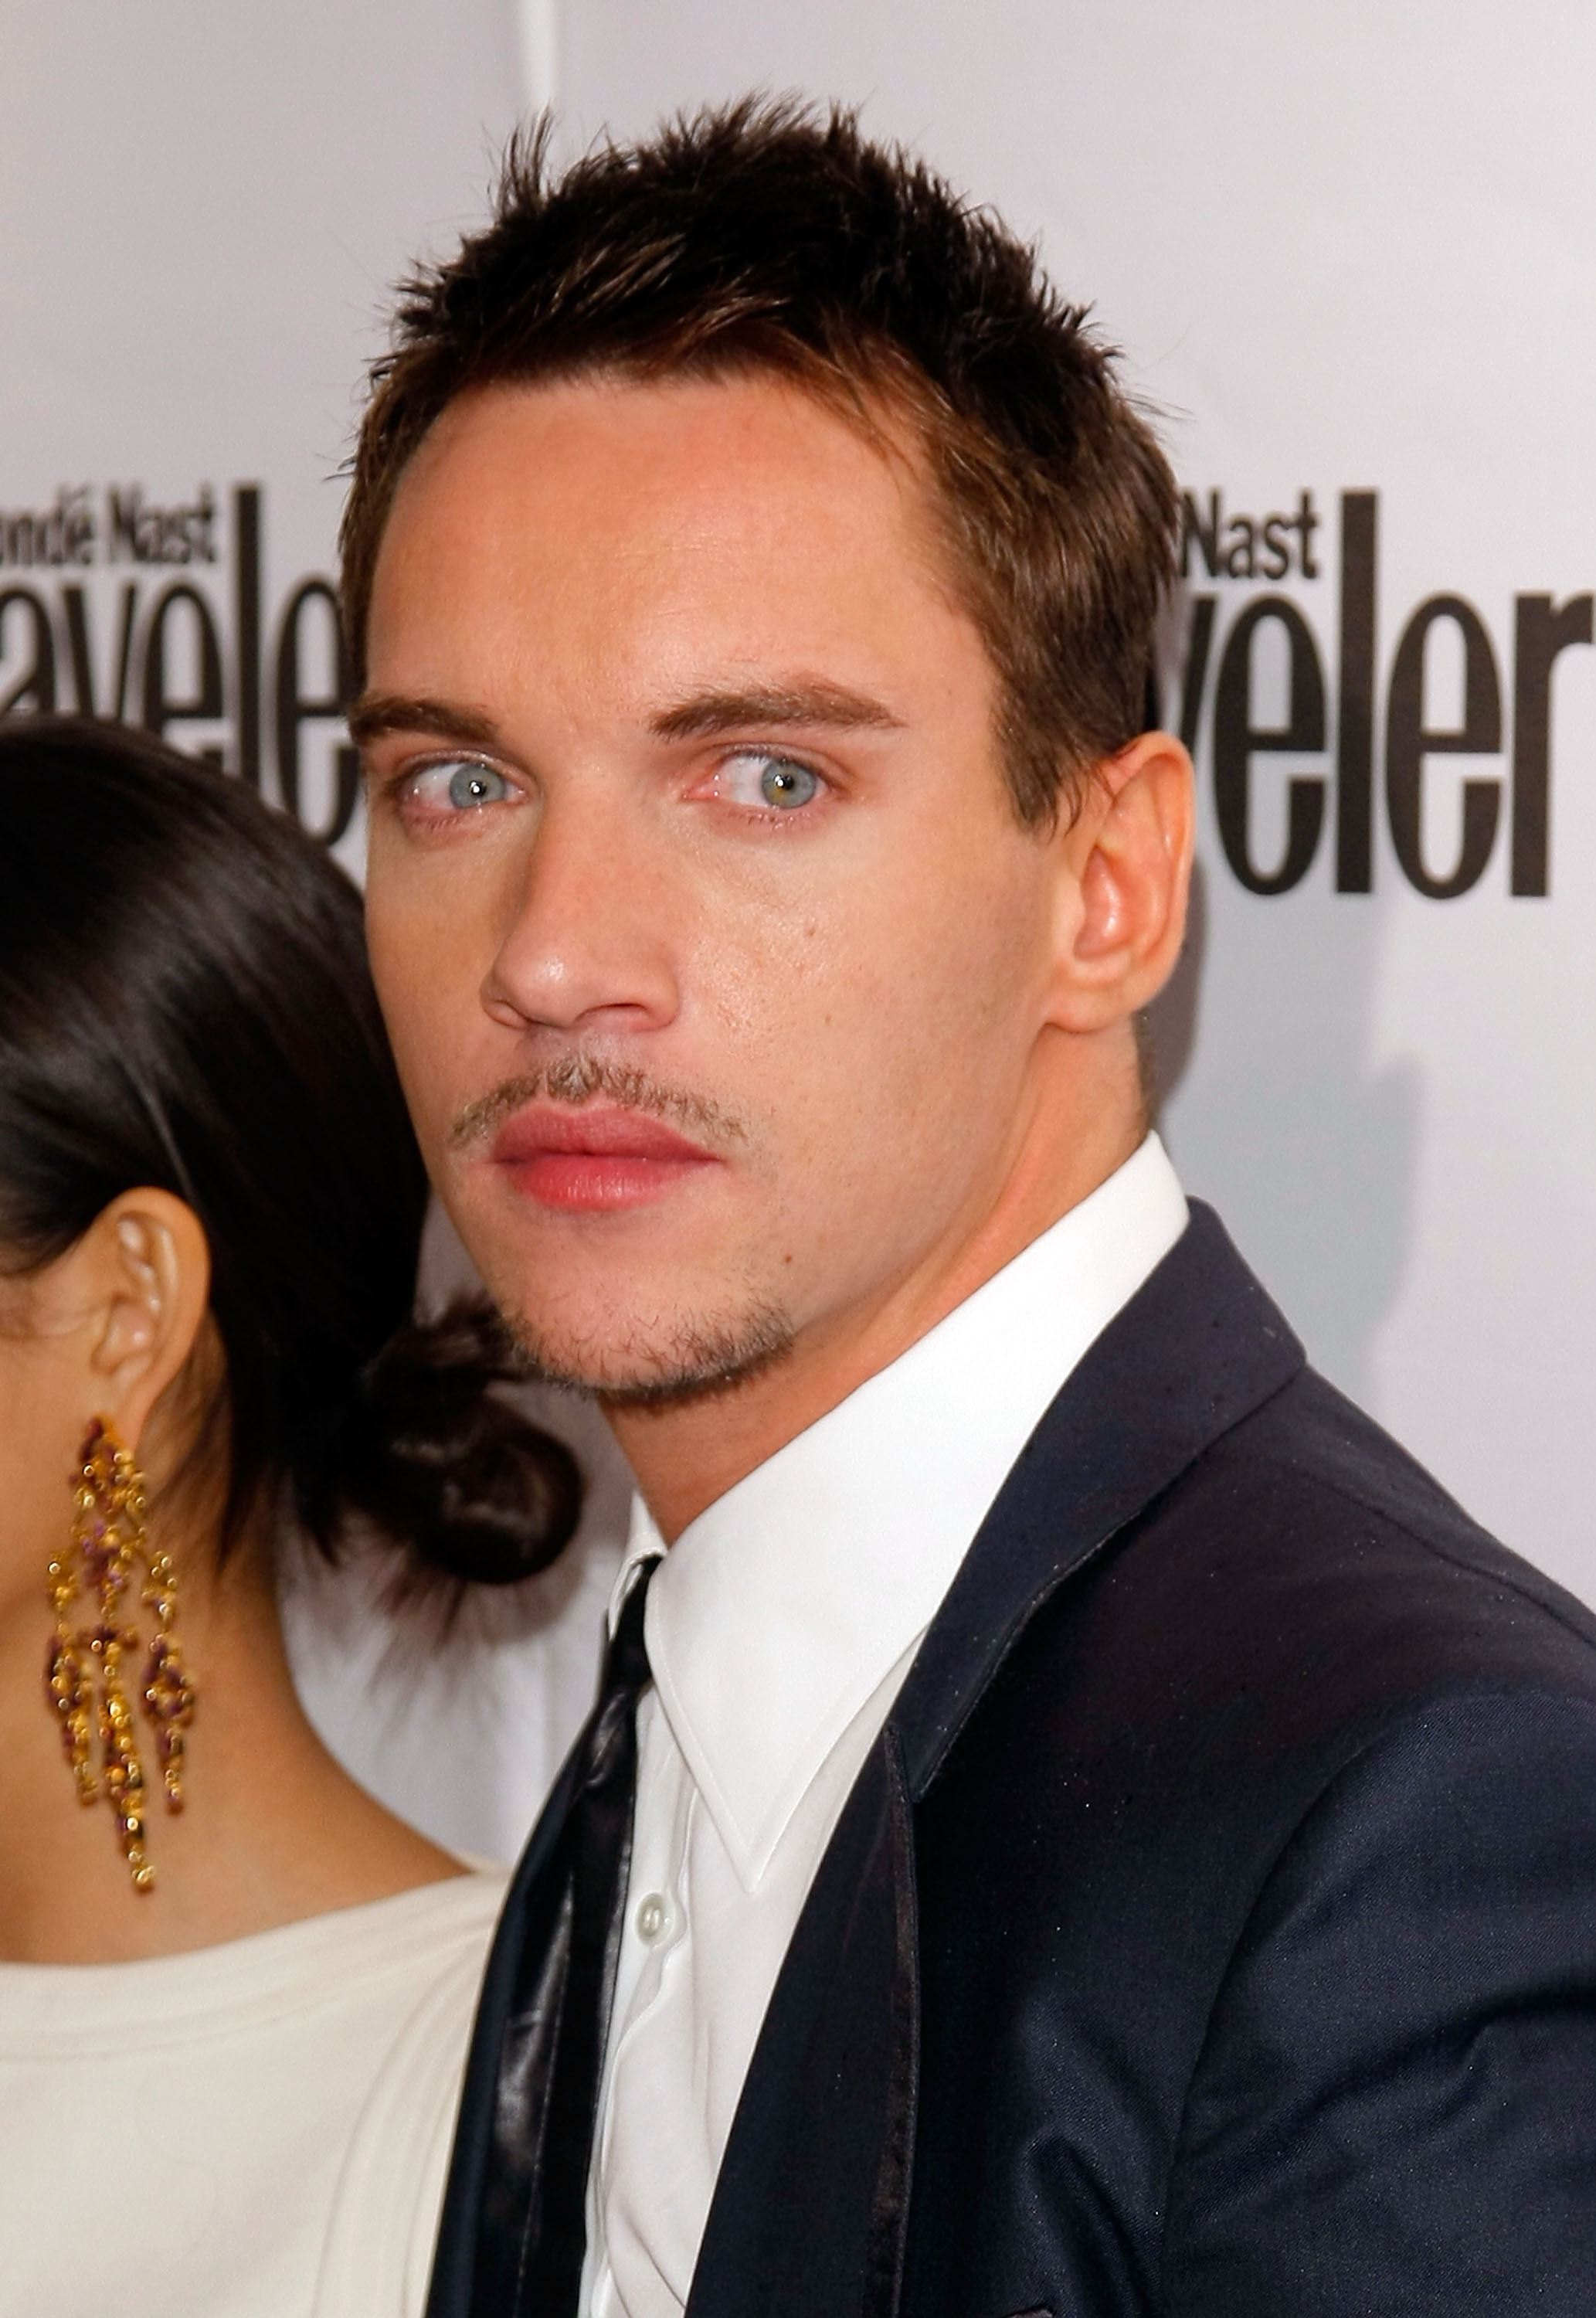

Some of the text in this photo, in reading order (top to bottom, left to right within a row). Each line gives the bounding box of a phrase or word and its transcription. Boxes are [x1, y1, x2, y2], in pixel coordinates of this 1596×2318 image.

[0, 483, 215, 566] ndé Nast
[1180, 488, 1319, 580] Nast
